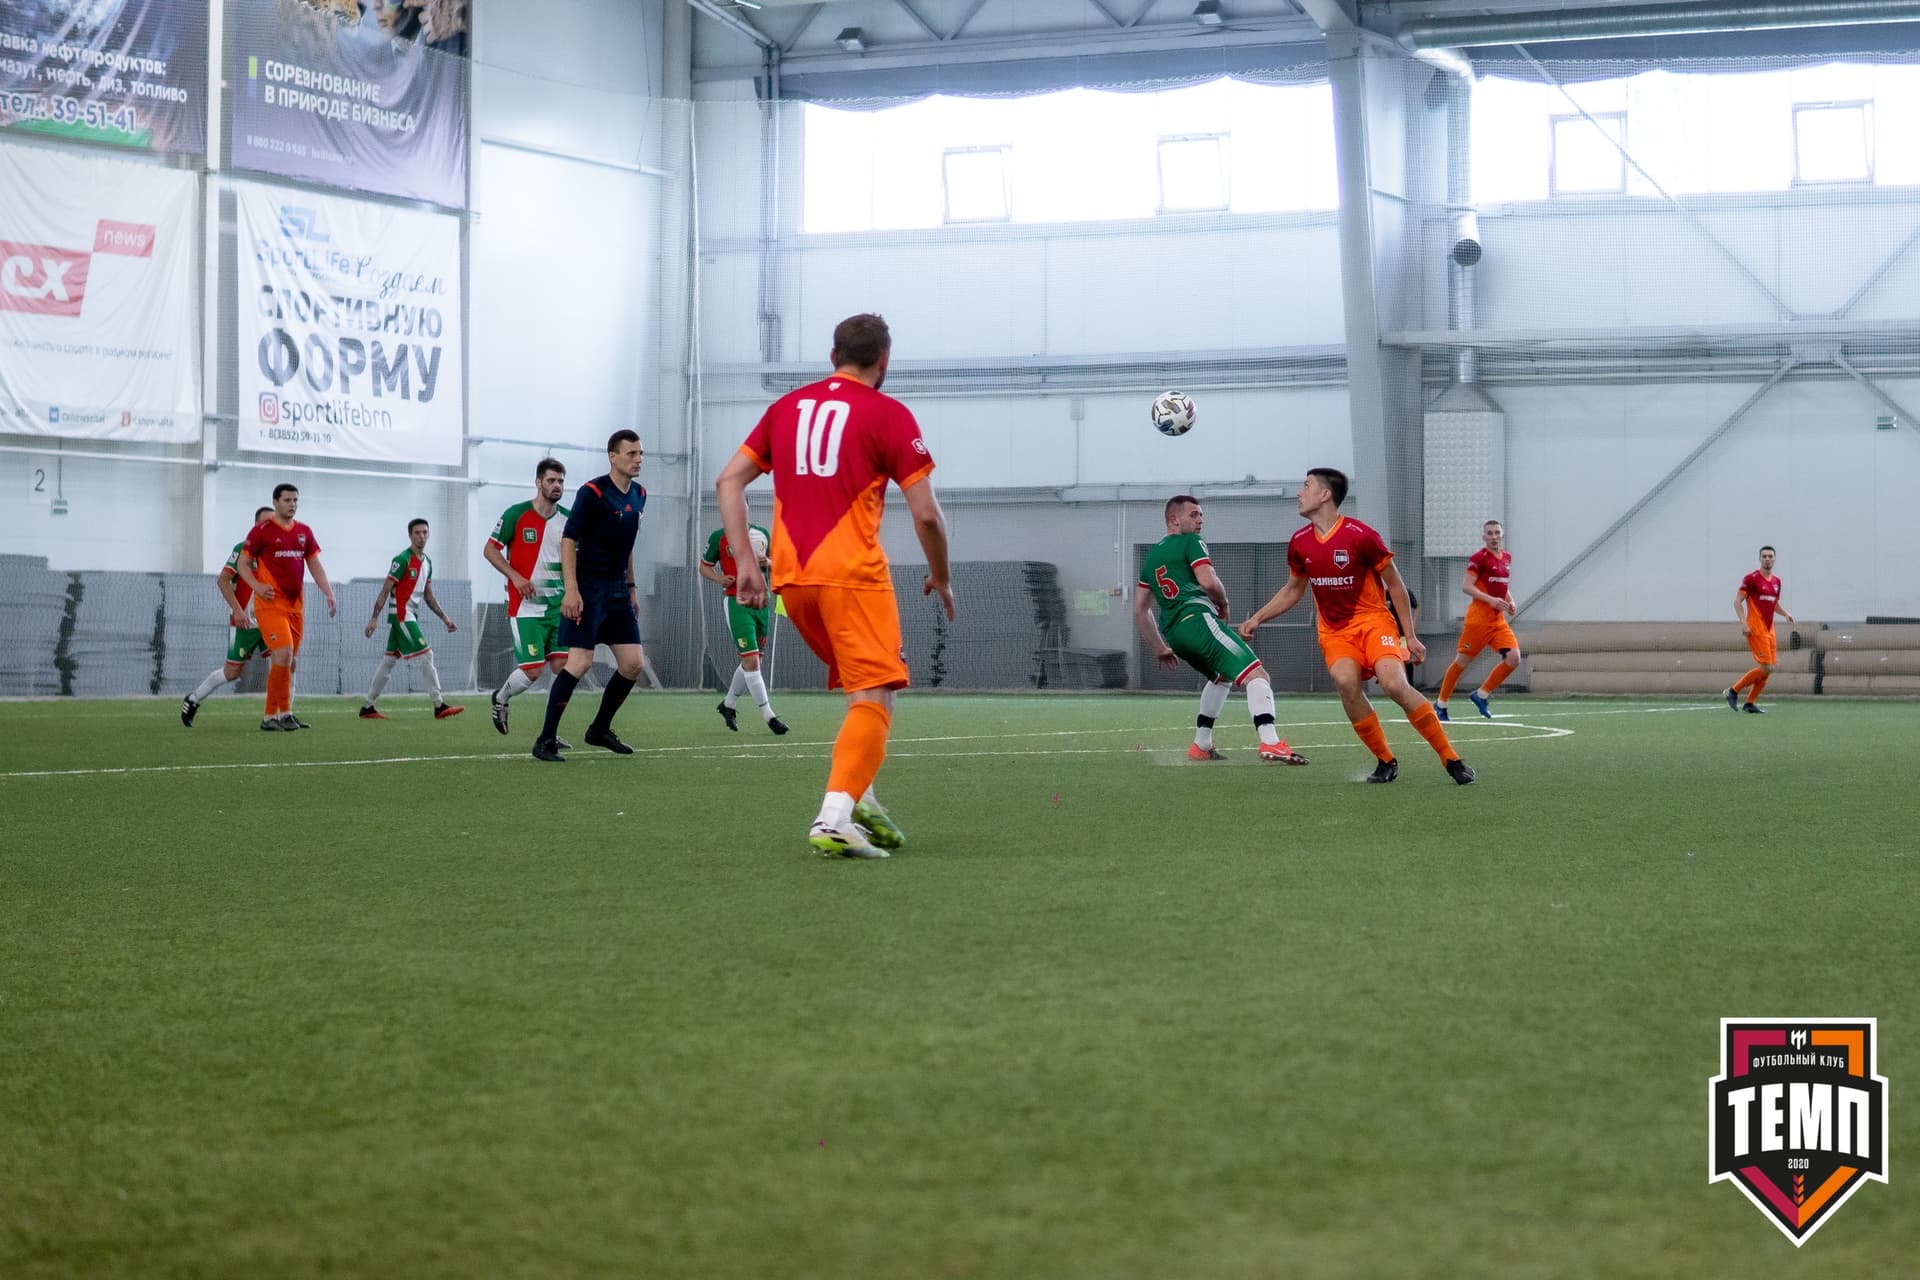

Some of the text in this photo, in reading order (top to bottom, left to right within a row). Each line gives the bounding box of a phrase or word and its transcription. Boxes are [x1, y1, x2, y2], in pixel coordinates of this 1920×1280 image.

[98, 76, 126, 94] диз.
[130, 80, 188, 103] топливо
[265, 60, 381, 101] СОРЕВНОВАНИЕ
[53, 98, 136, 133] 39-51-41
[264, 85, 416, 133] В ПРИРОДЕ БИЗНЕСА
[103, 229, 146, 248] news
[257, 327, 443, 403] ФОРМУ
[282, 399, 392, 428] sportlifebrn
[795, 398, 850, 477] 10
[35, 468, 45, 492] 2
[1155, 565, 1180, 599] 5
[1381, 635, 1395, 647] 22
